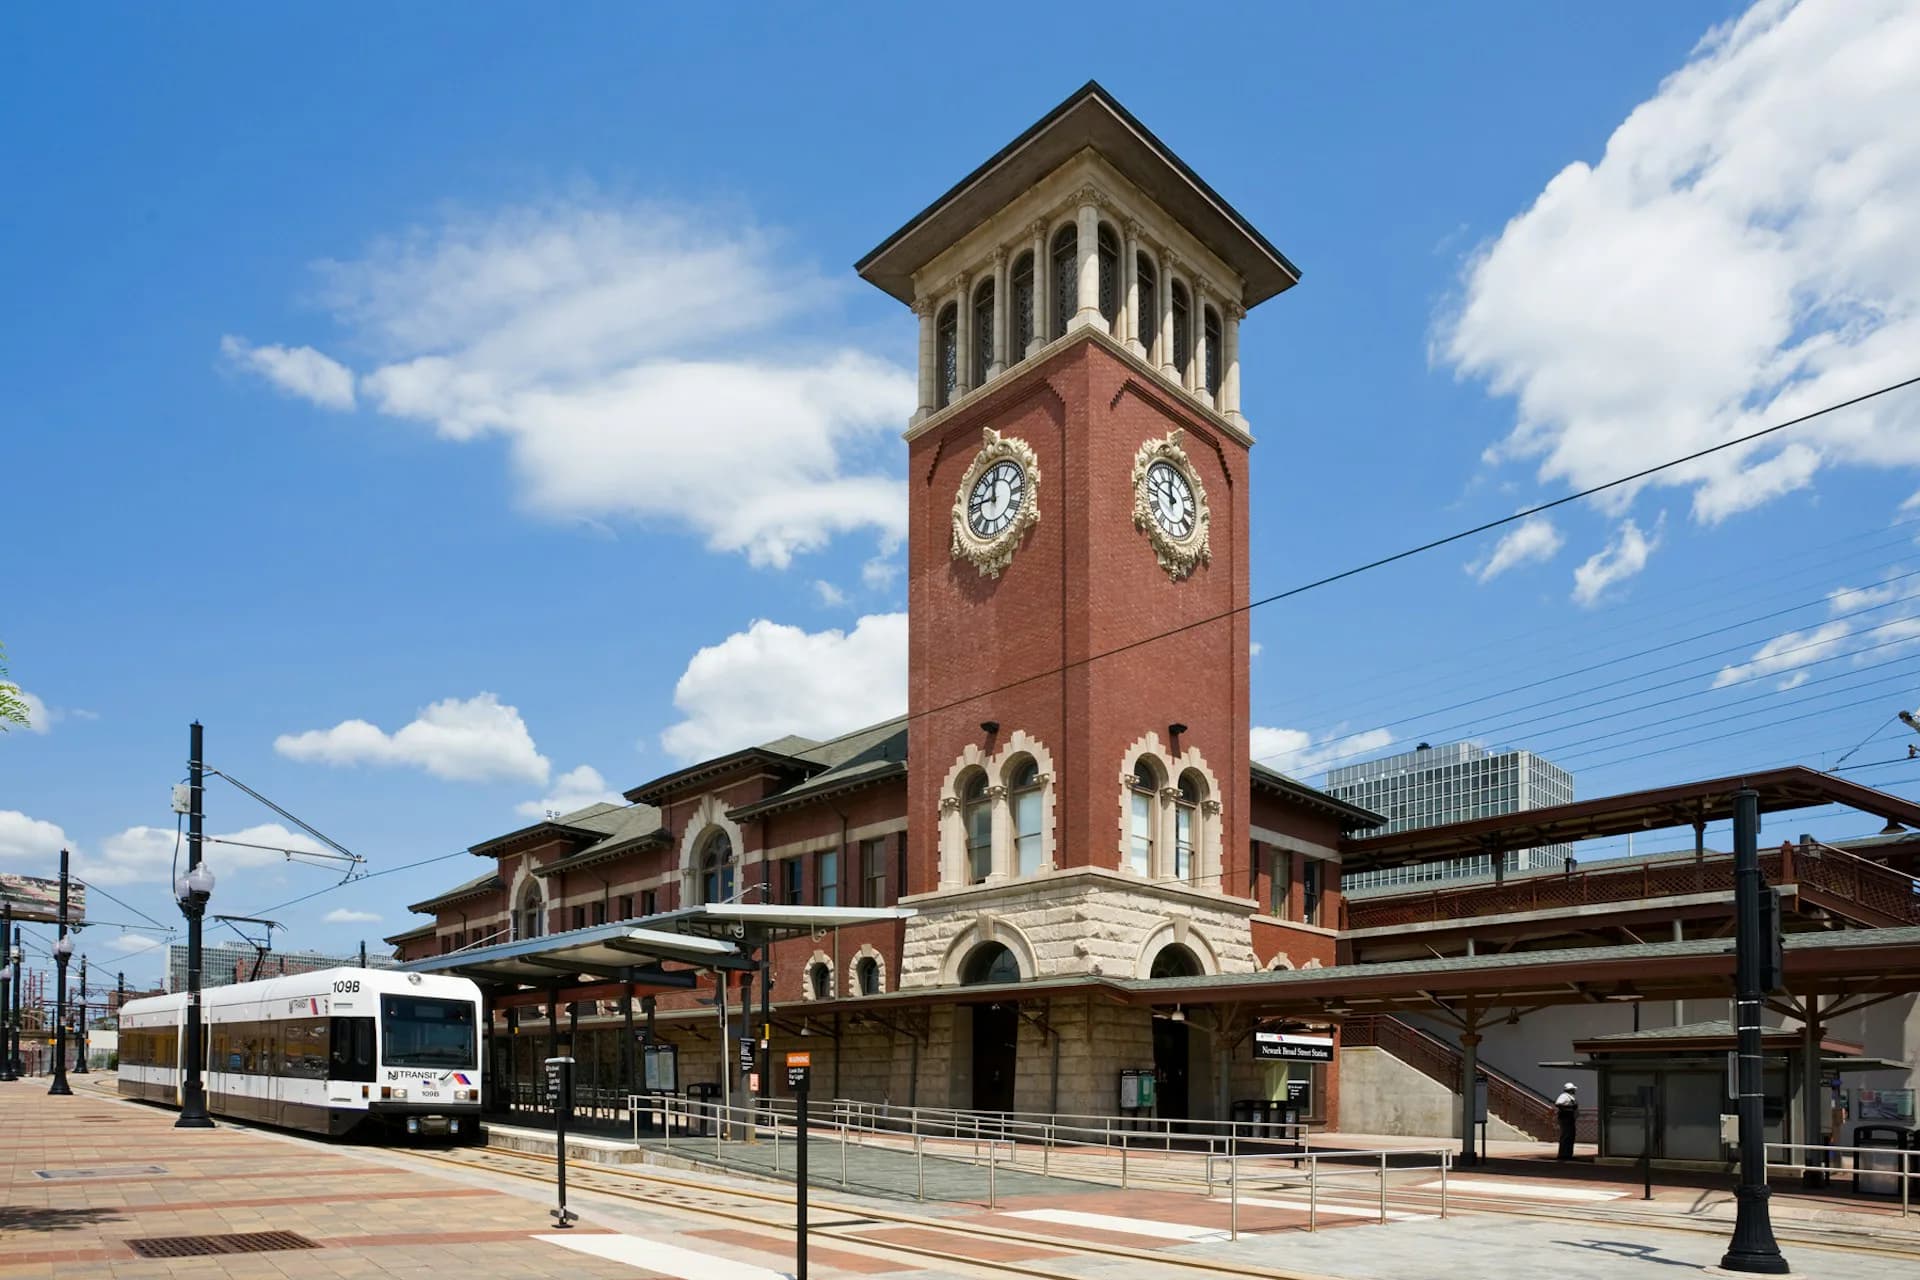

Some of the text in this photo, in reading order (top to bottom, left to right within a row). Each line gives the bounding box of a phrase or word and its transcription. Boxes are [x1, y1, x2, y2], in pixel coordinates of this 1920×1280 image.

[332, 980, 361, 993] 109B
[1262, 1045, 1282, 1055] Newark
[1312, 1048, 1328, 1058] Station
[399, 1070, 438, 1079] TRANSIT
